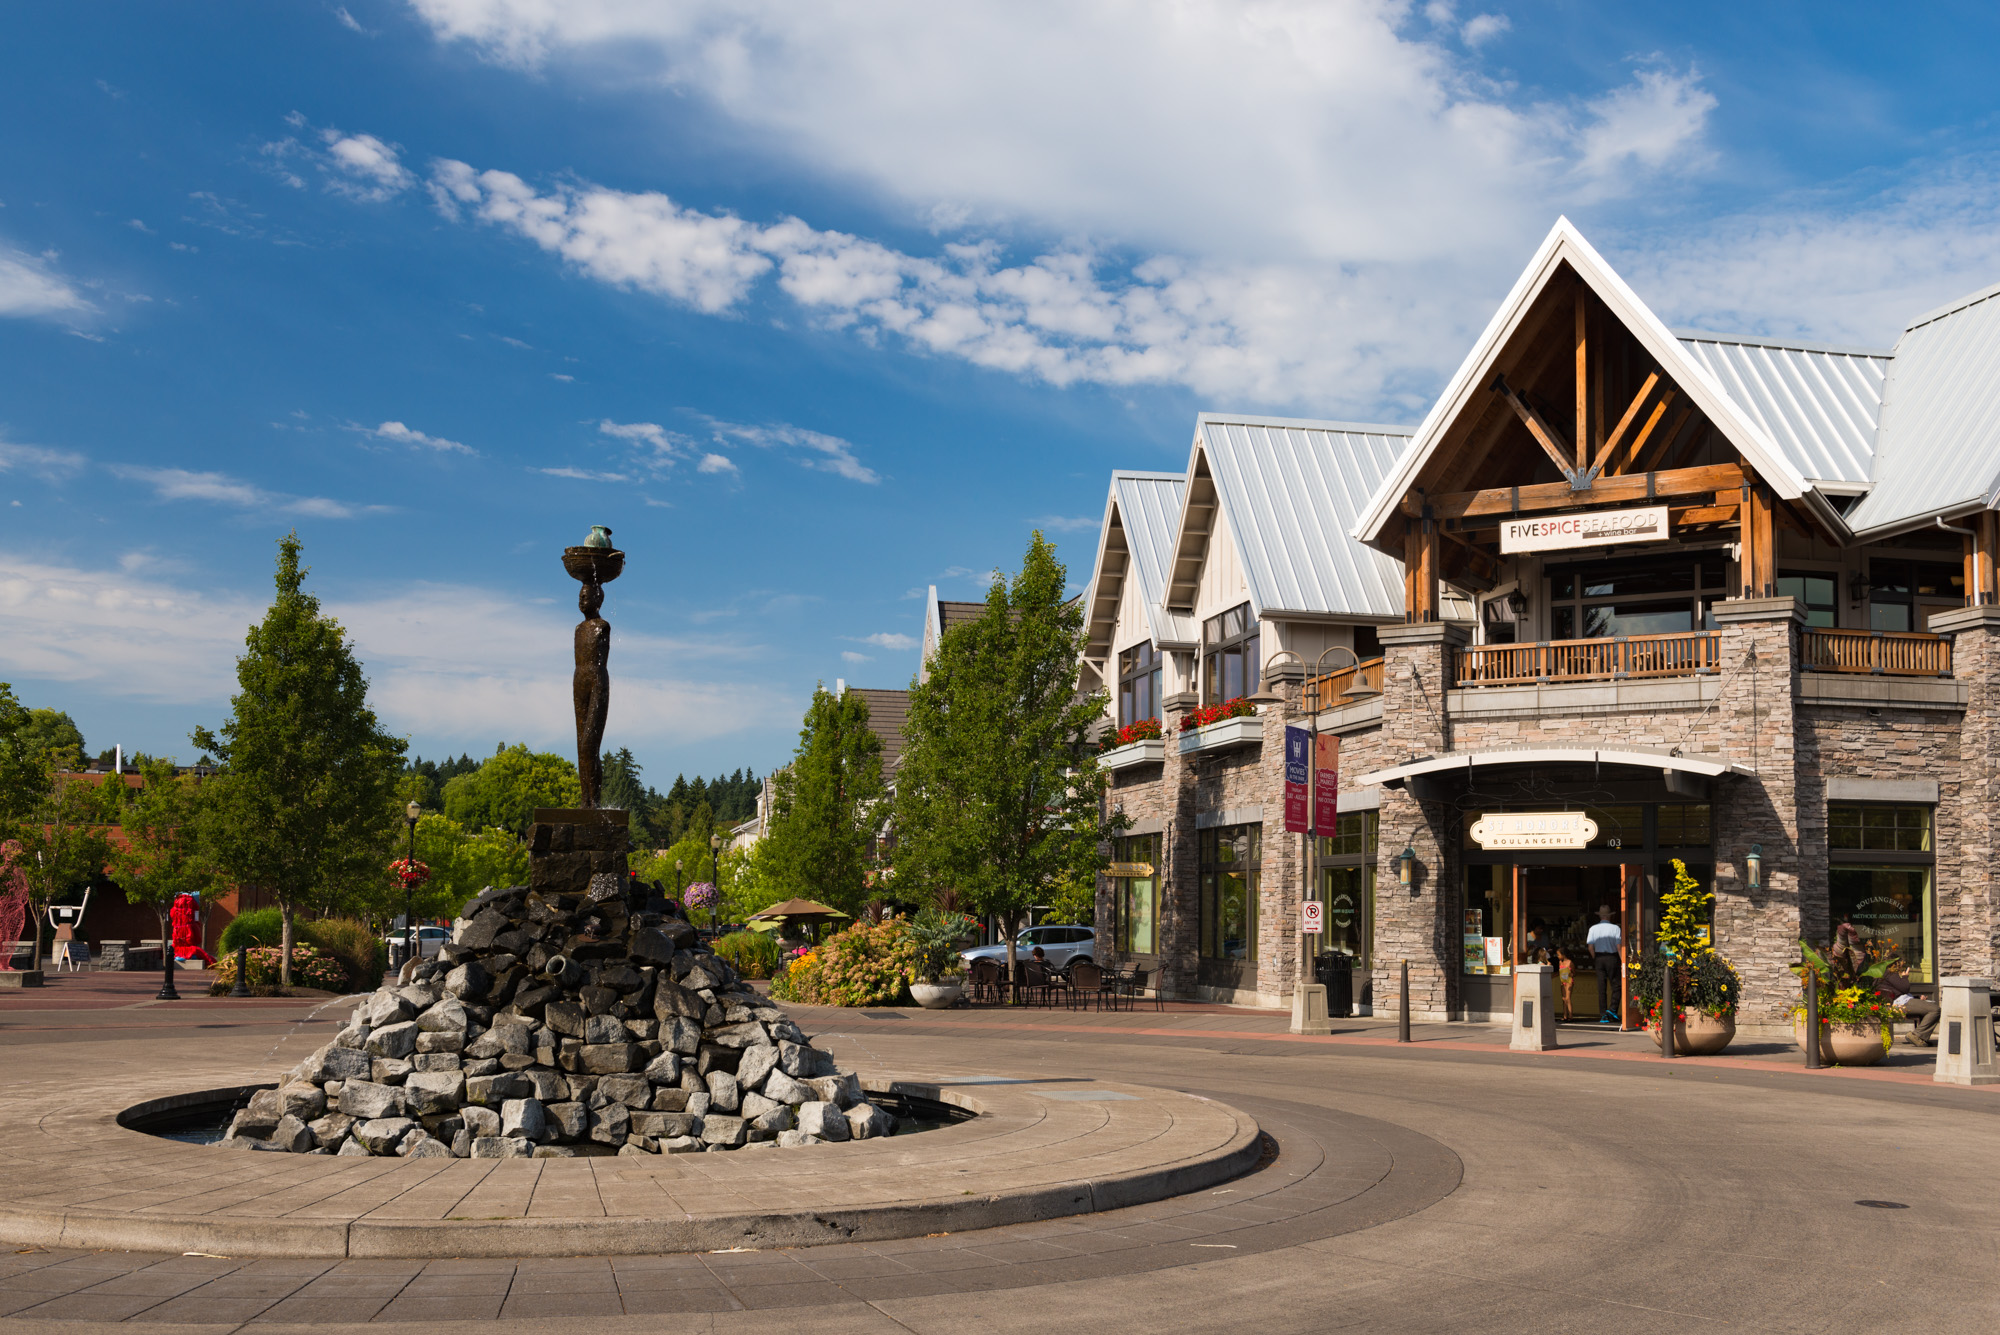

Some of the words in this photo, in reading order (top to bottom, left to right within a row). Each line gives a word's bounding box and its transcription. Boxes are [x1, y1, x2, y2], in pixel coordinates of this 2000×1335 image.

[1604, 528, 1622, 537] wine
[1623, 527, 1637, 535] bar
[1489, 820, 1504, 831] ST
[1516, 815, 1581, 831] HONORÉ
[1493, 837, 1575, 845] BOULANGERIE
[1856, 896, 1905, 911] BOULANGERIE
